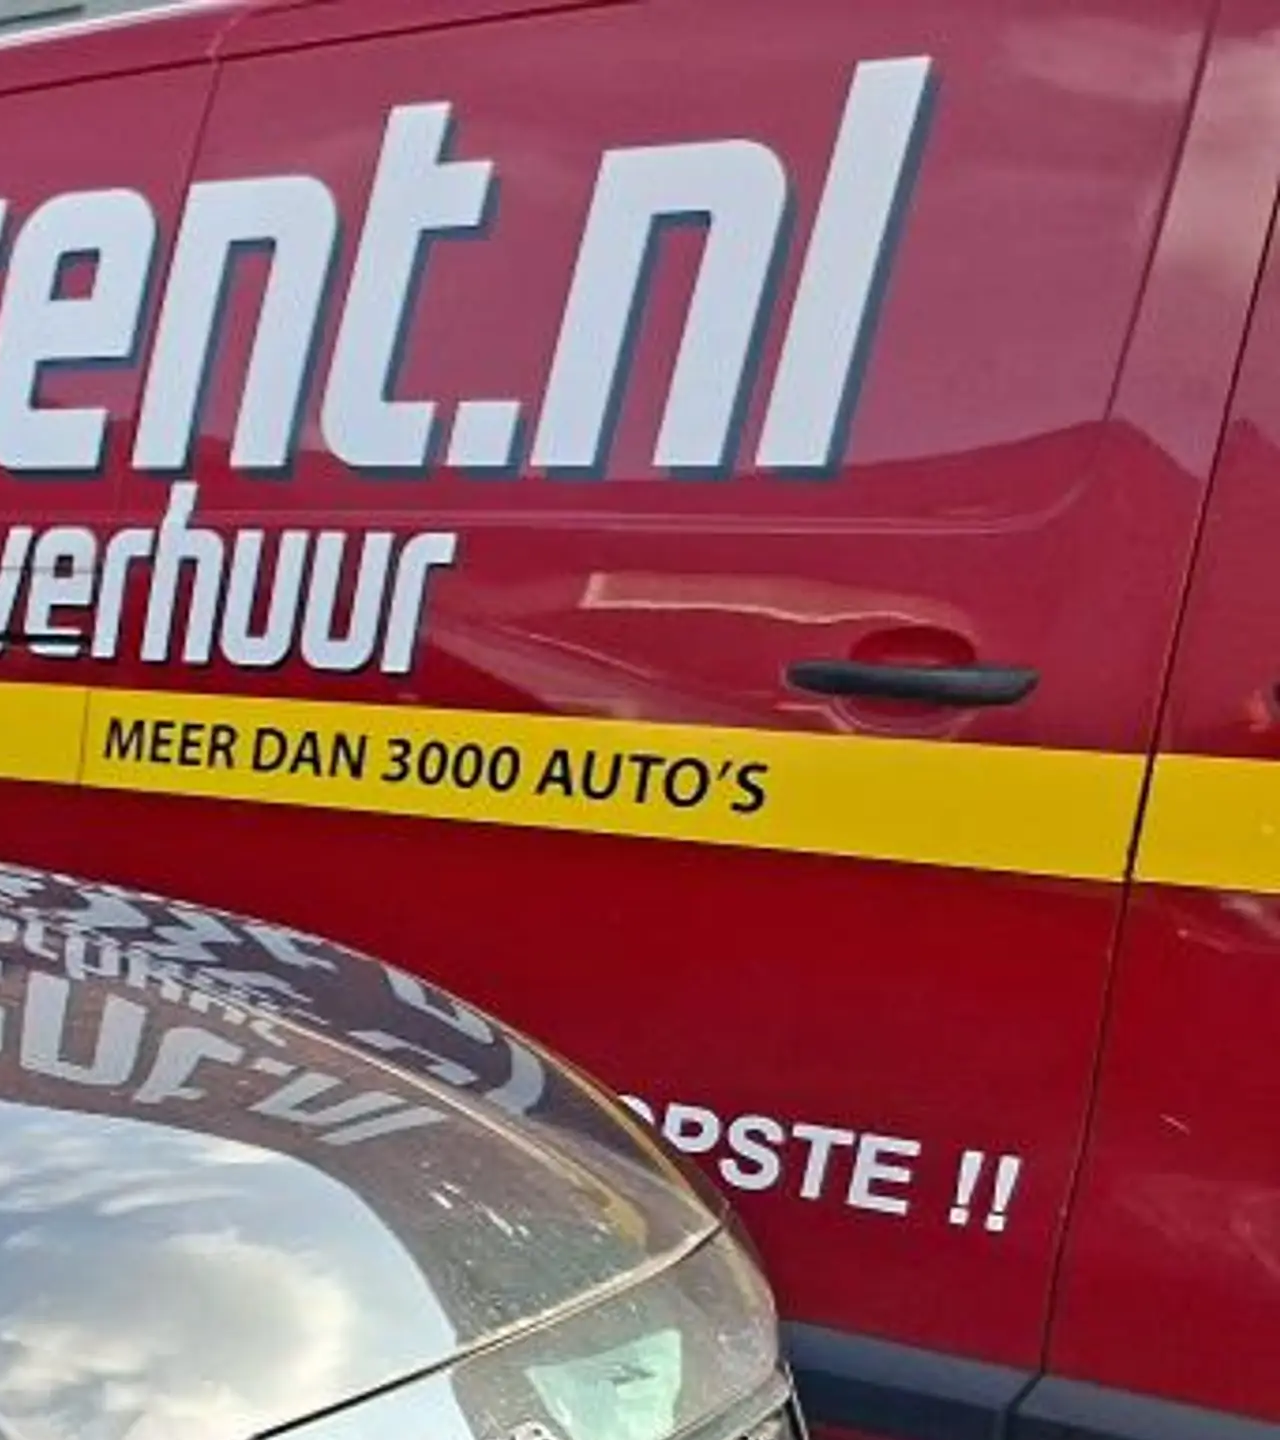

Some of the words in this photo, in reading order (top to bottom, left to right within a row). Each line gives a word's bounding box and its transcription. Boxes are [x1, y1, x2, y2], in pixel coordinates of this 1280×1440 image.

[103, 716, 237, 769] MEER
[250, 728, 368, 780] DAN
[381, 736, 521, 792] 3000
